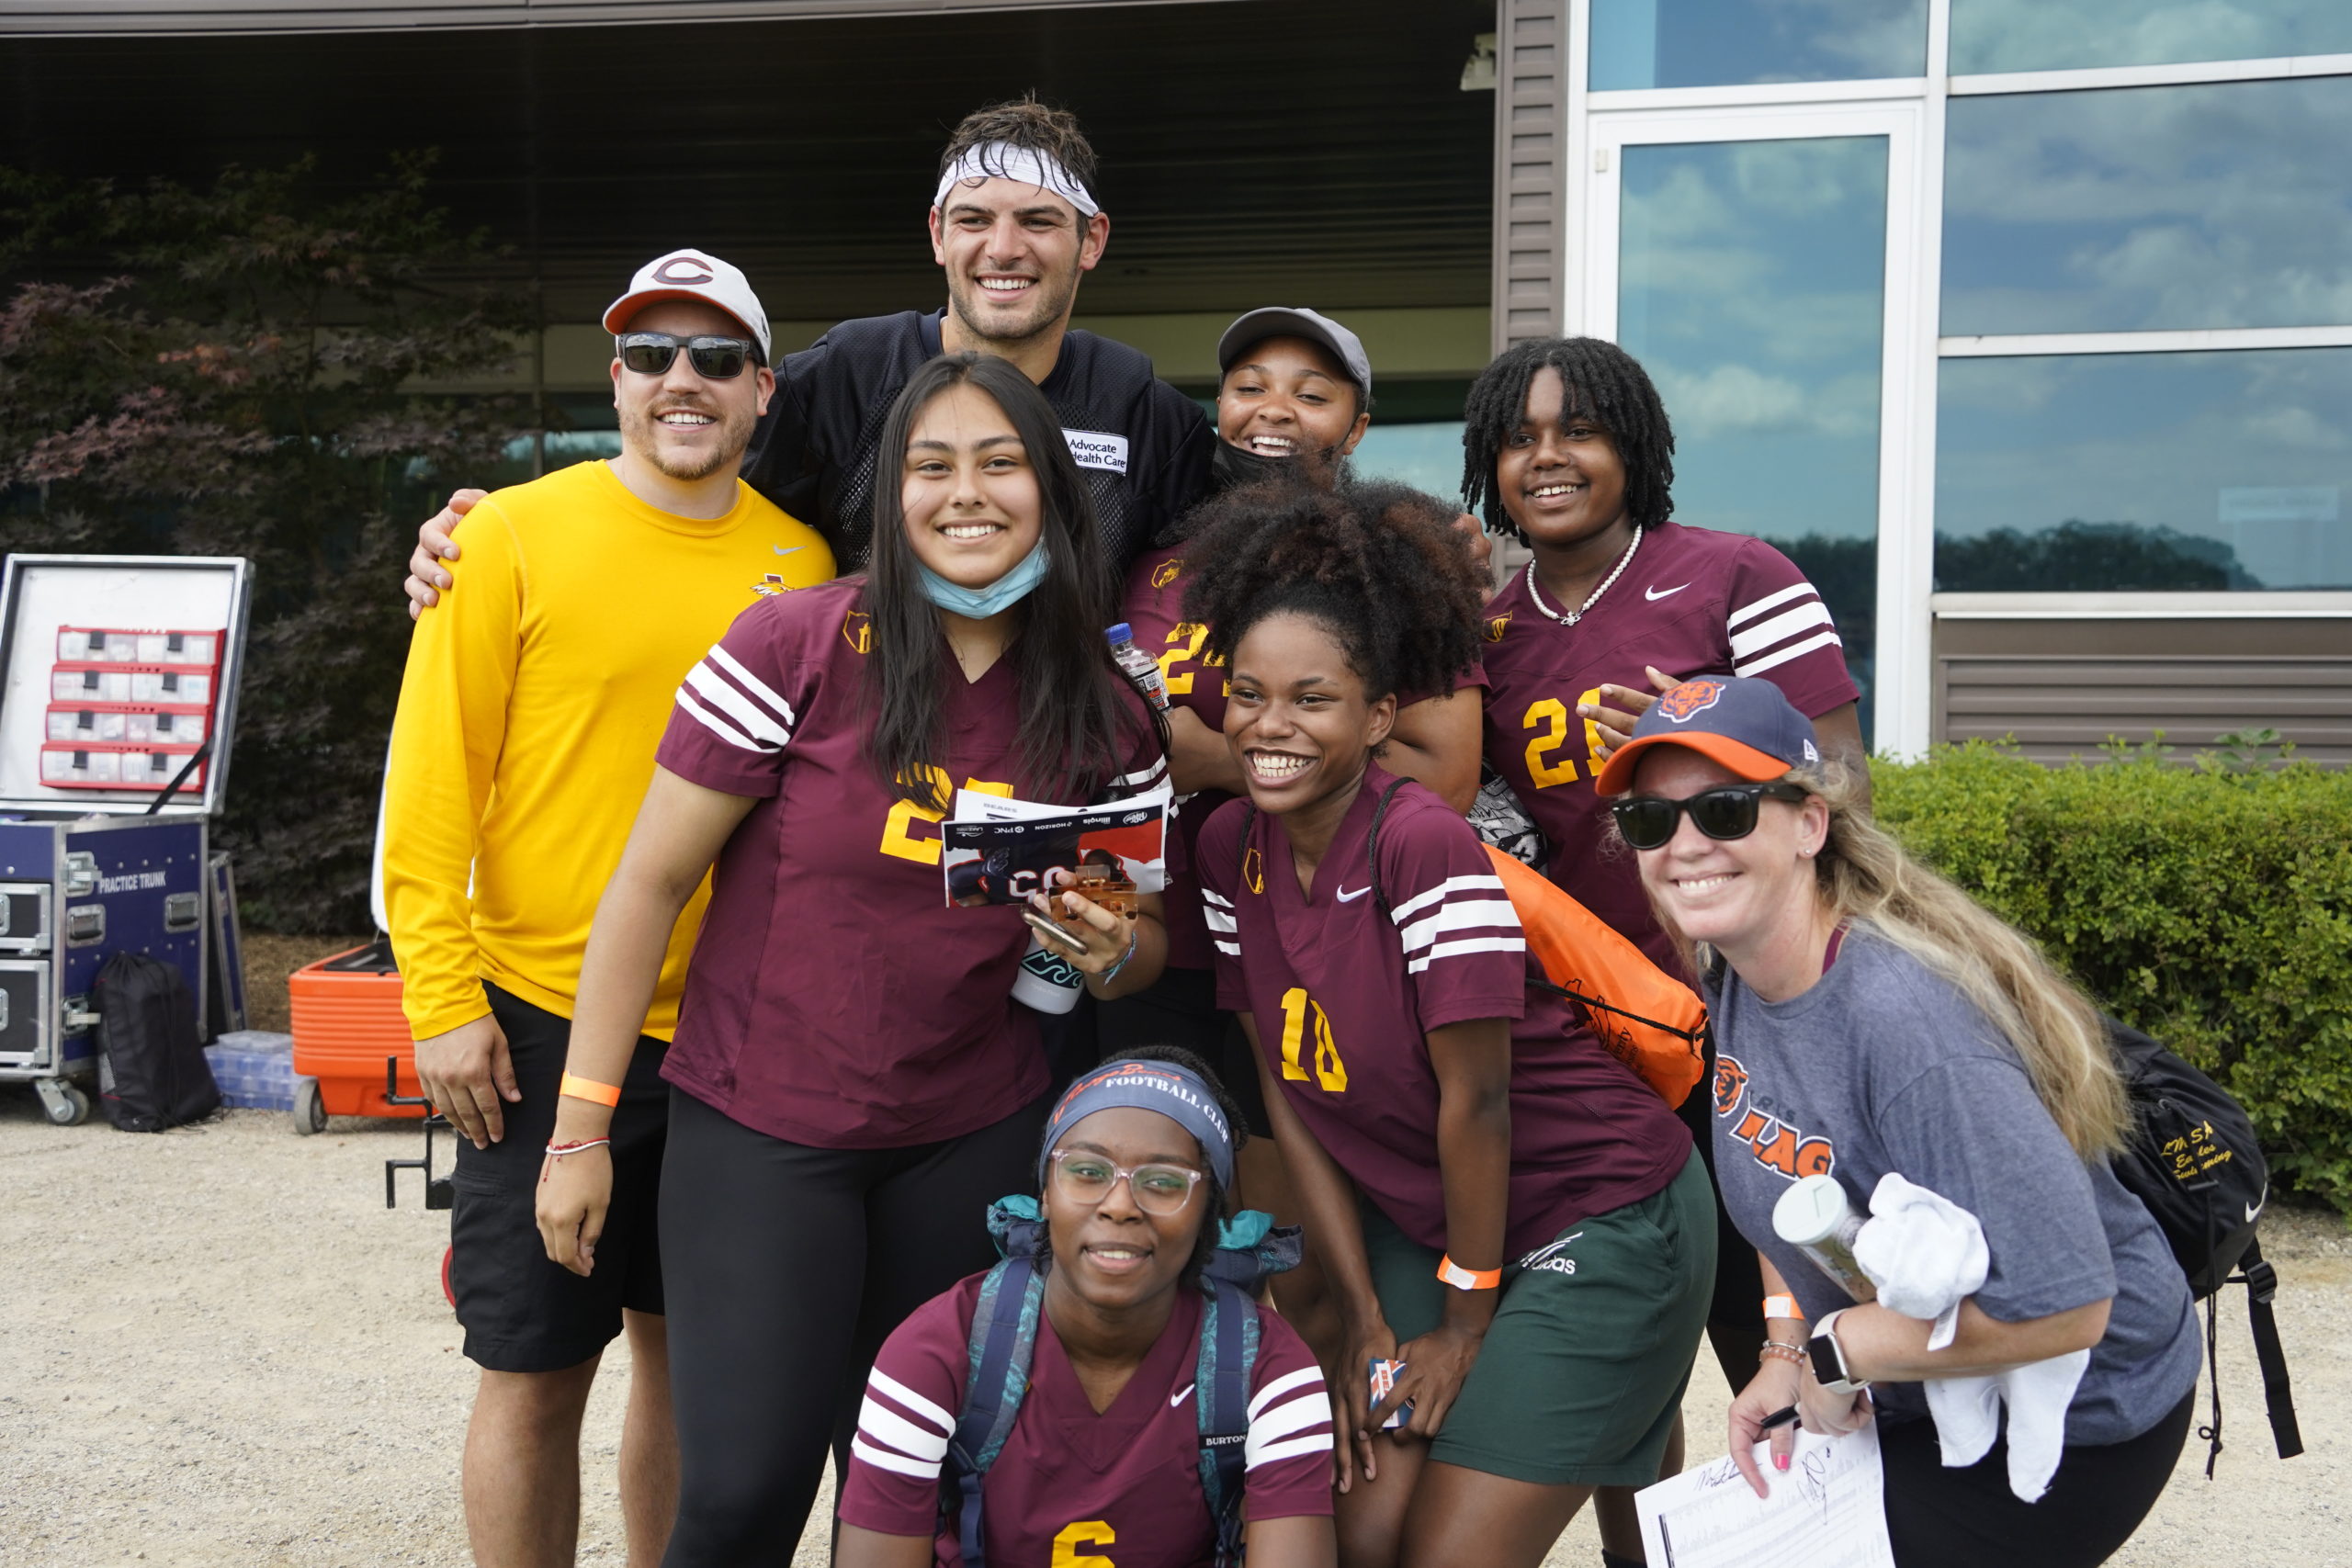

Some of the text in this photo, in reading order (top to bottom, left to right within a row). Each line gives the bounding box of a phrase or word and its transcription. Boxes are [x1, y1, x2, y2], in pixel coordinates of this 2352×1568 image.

[651, 256, 714, 286] C
[1069, 438, 1117, 454] Advocate
[1103, 455, 1125, 468] Care
[879, 761, 1013, 866] 2
[994, 826, 1013, 834] PNC
[98, 870, 166, 895] PRACTICE TRUNK
[1280, 987, 1348, 1093] 10
[1105, 1076, 1200, 1110] FOOTBALL
[1205, 1434, 1247, 1447] BURTON
